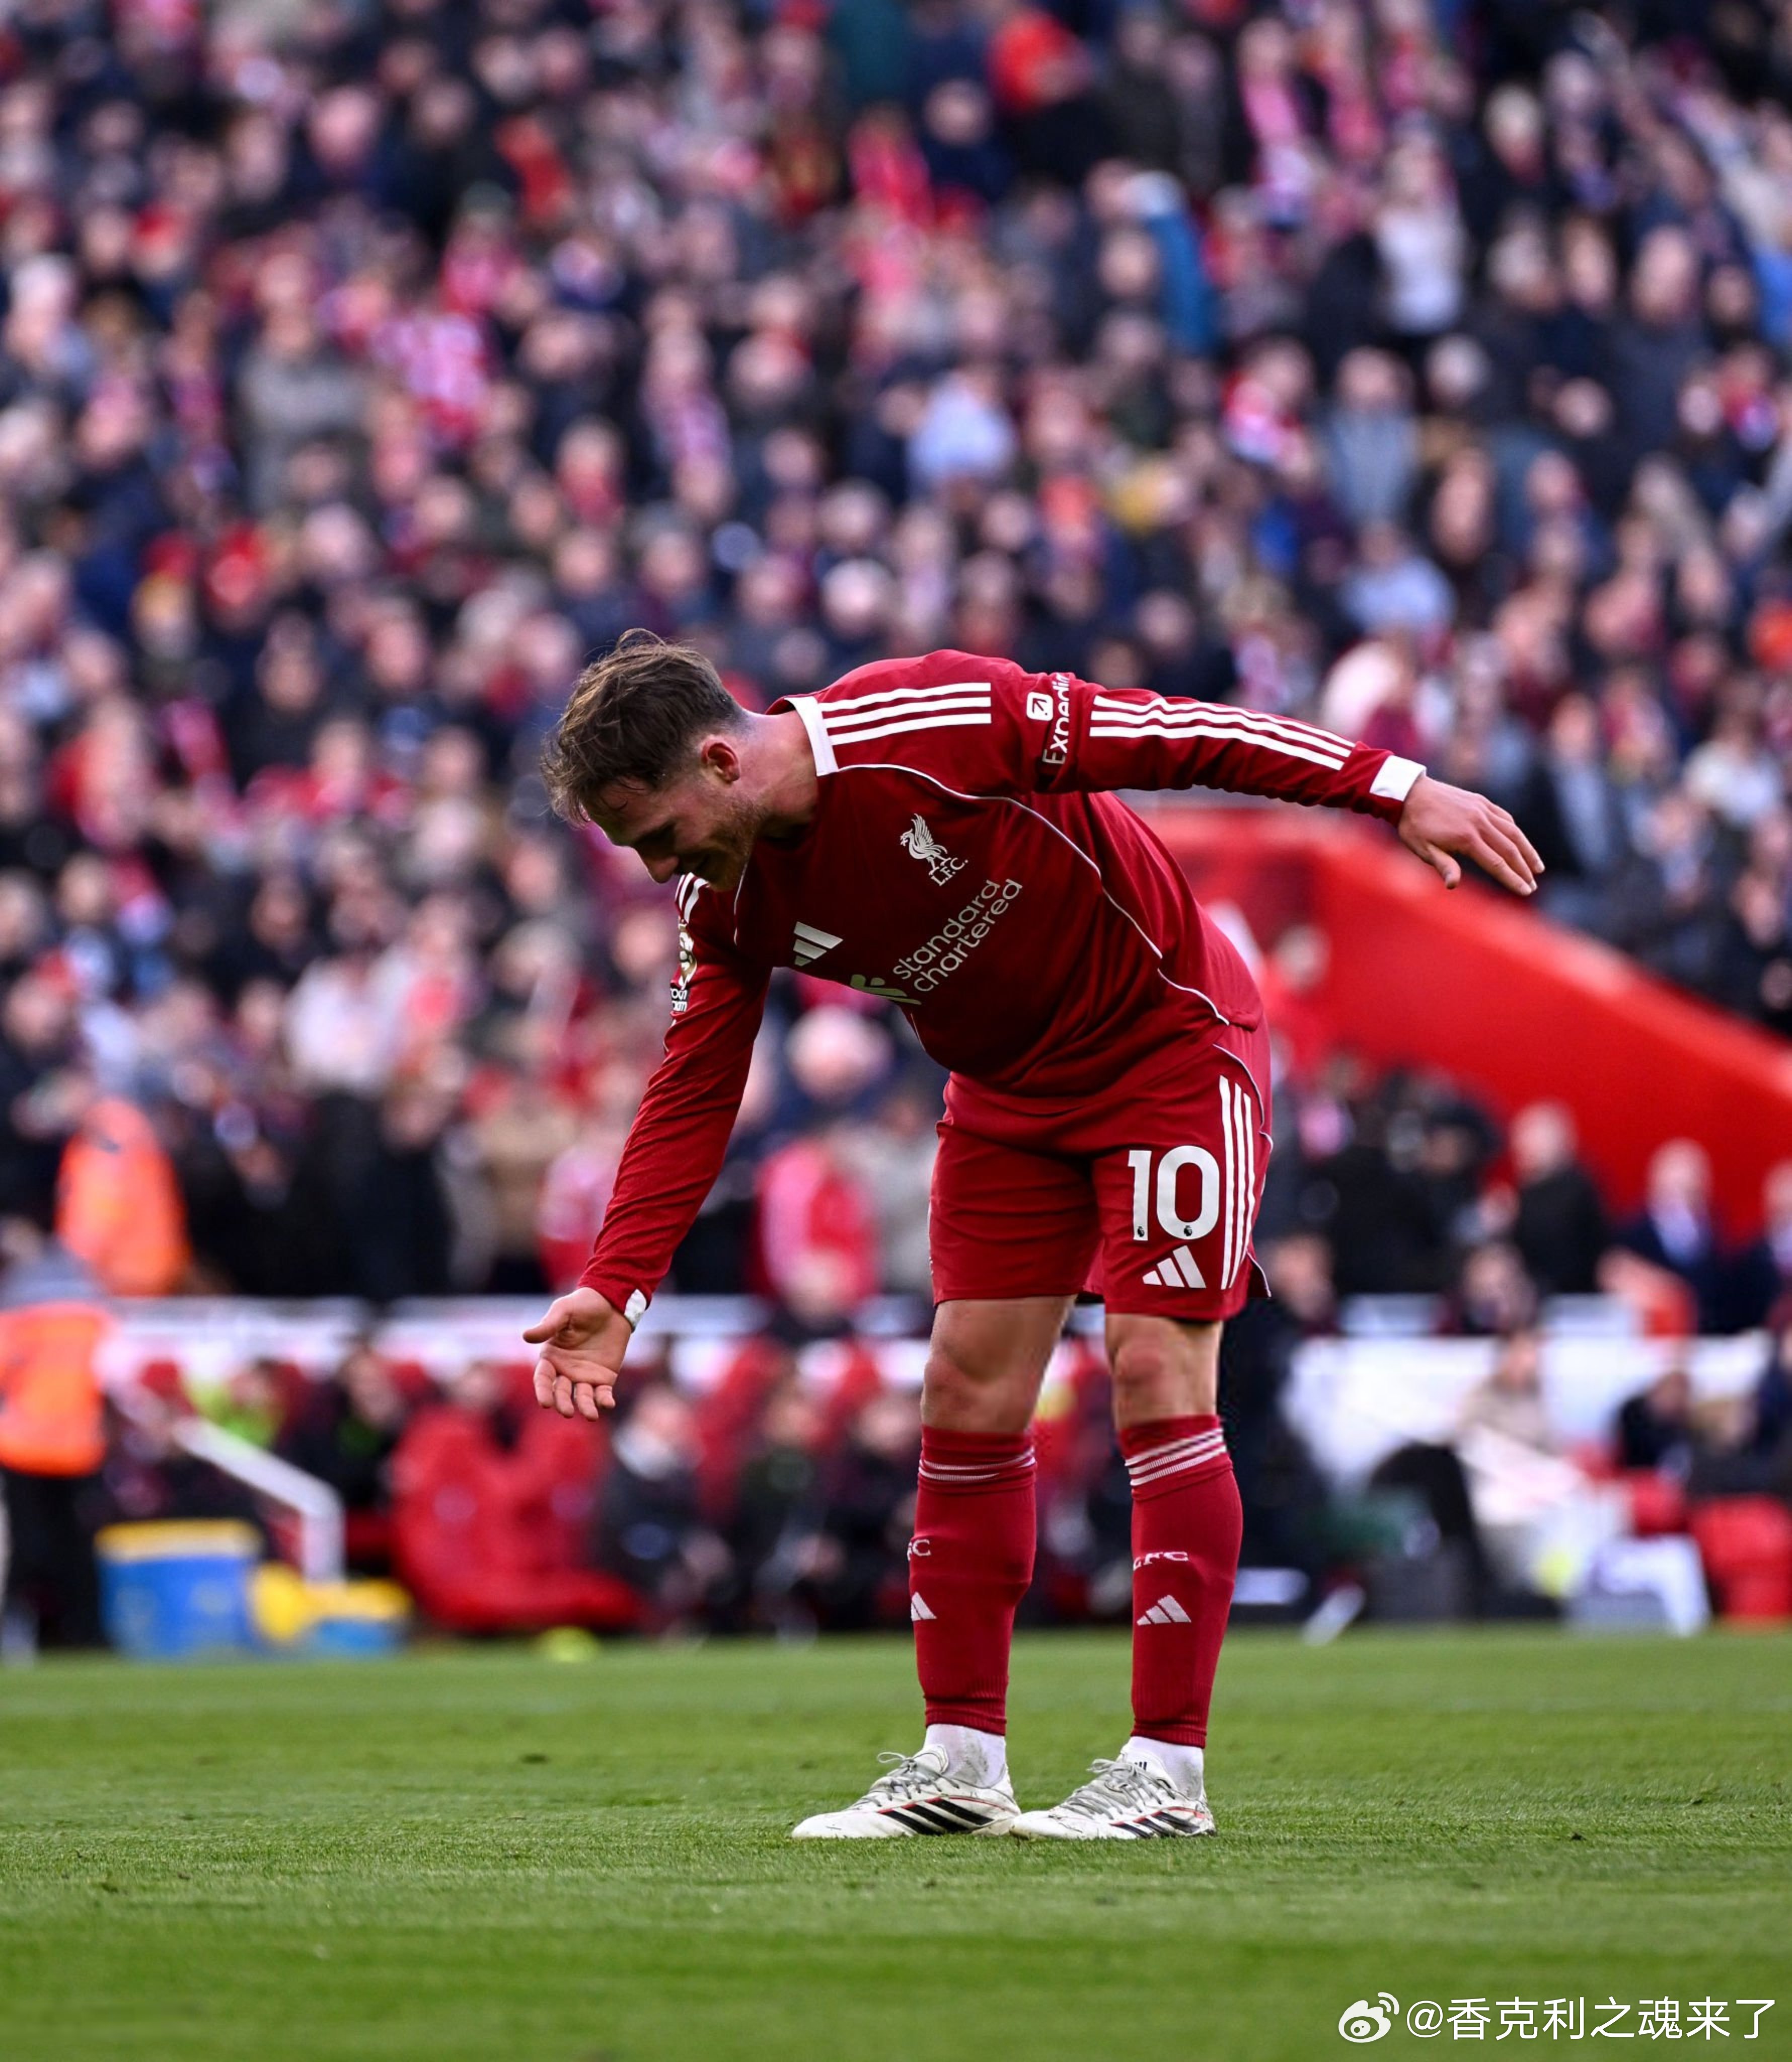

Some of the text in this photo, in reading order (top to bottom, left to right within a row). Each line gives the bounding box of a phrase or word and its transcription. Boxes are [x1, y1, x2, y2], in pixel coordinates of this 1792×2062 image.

[892, 879, 1000, 980] standard
[913, 878, 1023, 992] chartered
[1127, 1145, 1220, 1241] 10
